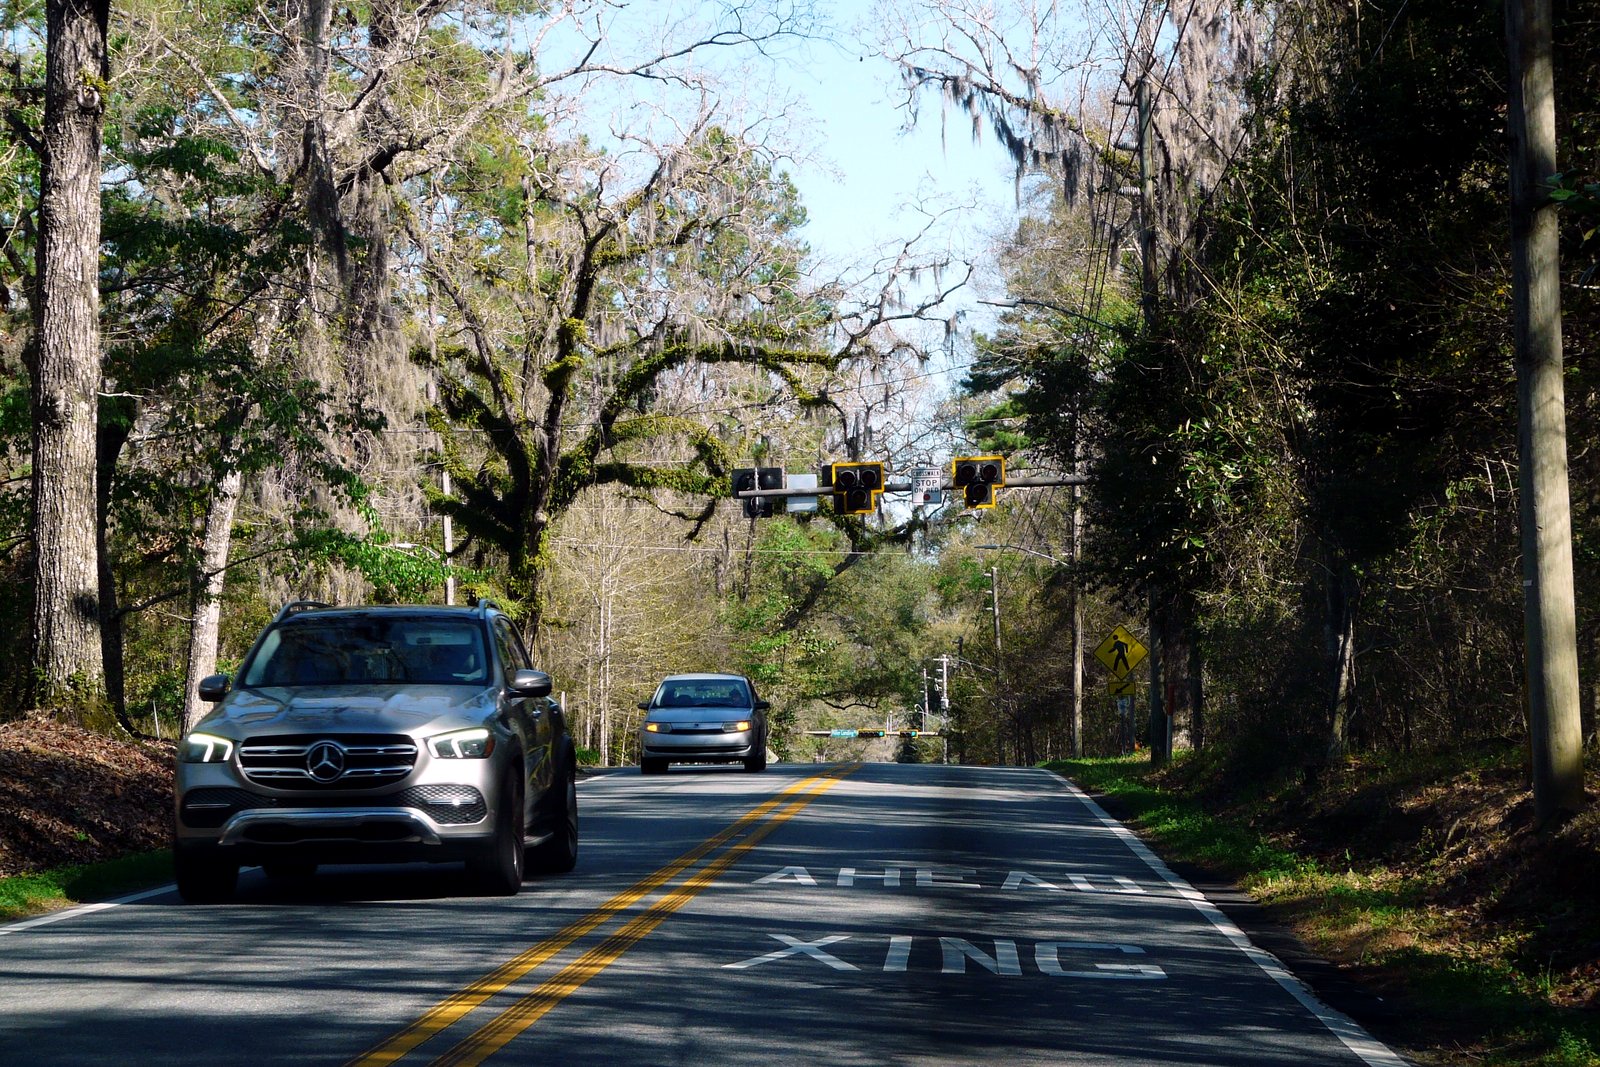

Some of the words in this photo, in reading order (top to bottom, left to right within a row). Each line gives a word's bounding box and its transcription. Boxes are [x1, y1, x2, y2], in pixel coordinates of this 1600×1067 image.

[916, 480, 938, 488] STOP
[752, 866, 1147, 893] AHEAD
[721, 934, 1168, 979] XING
